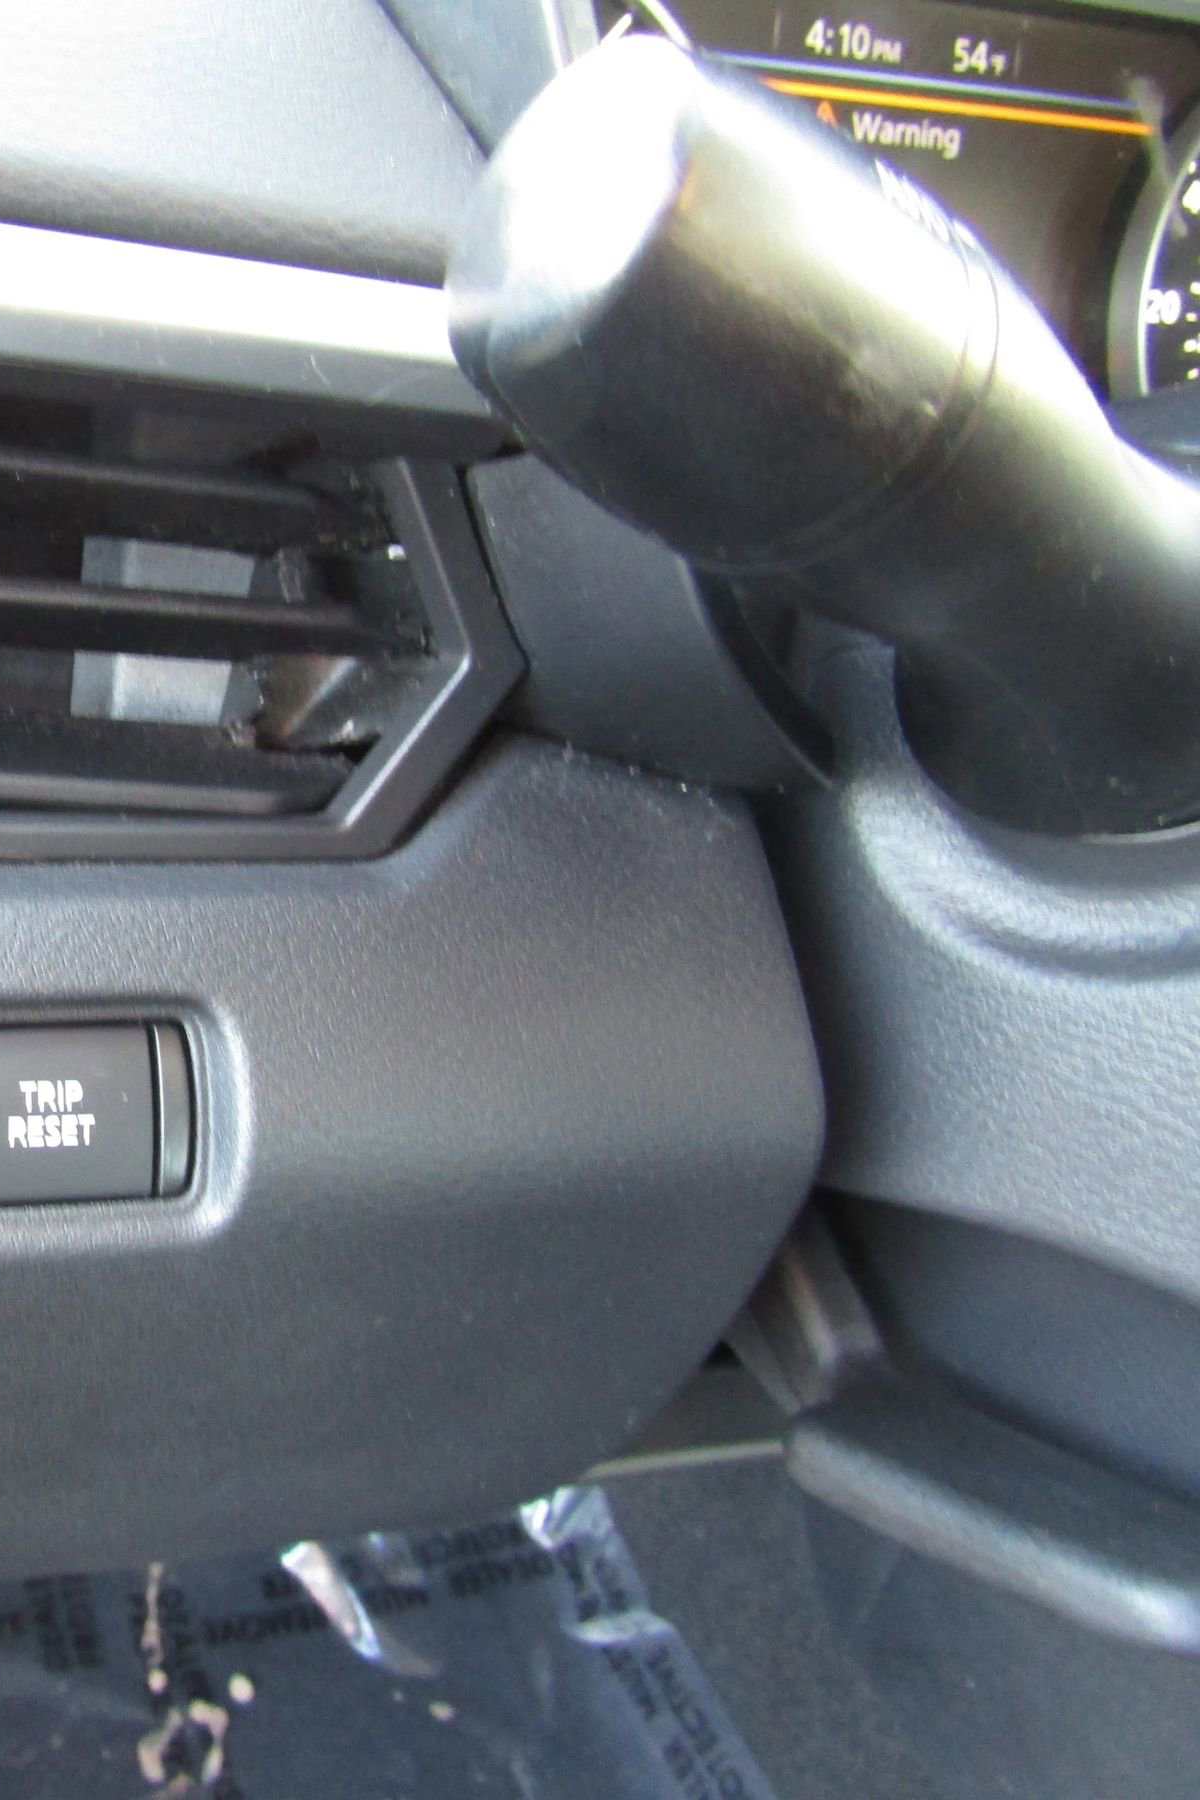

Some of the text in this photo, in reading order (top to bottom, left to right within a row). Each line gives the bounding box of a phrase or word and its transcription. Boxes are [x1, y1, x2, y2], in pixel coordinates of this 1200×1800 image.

[851, 111, 961, 160] Warning
[1147, 288, 1181, 325] 20
[18, 1079, 84, 1114] TRIP
[8, 1113, 96, 1149] RESET
